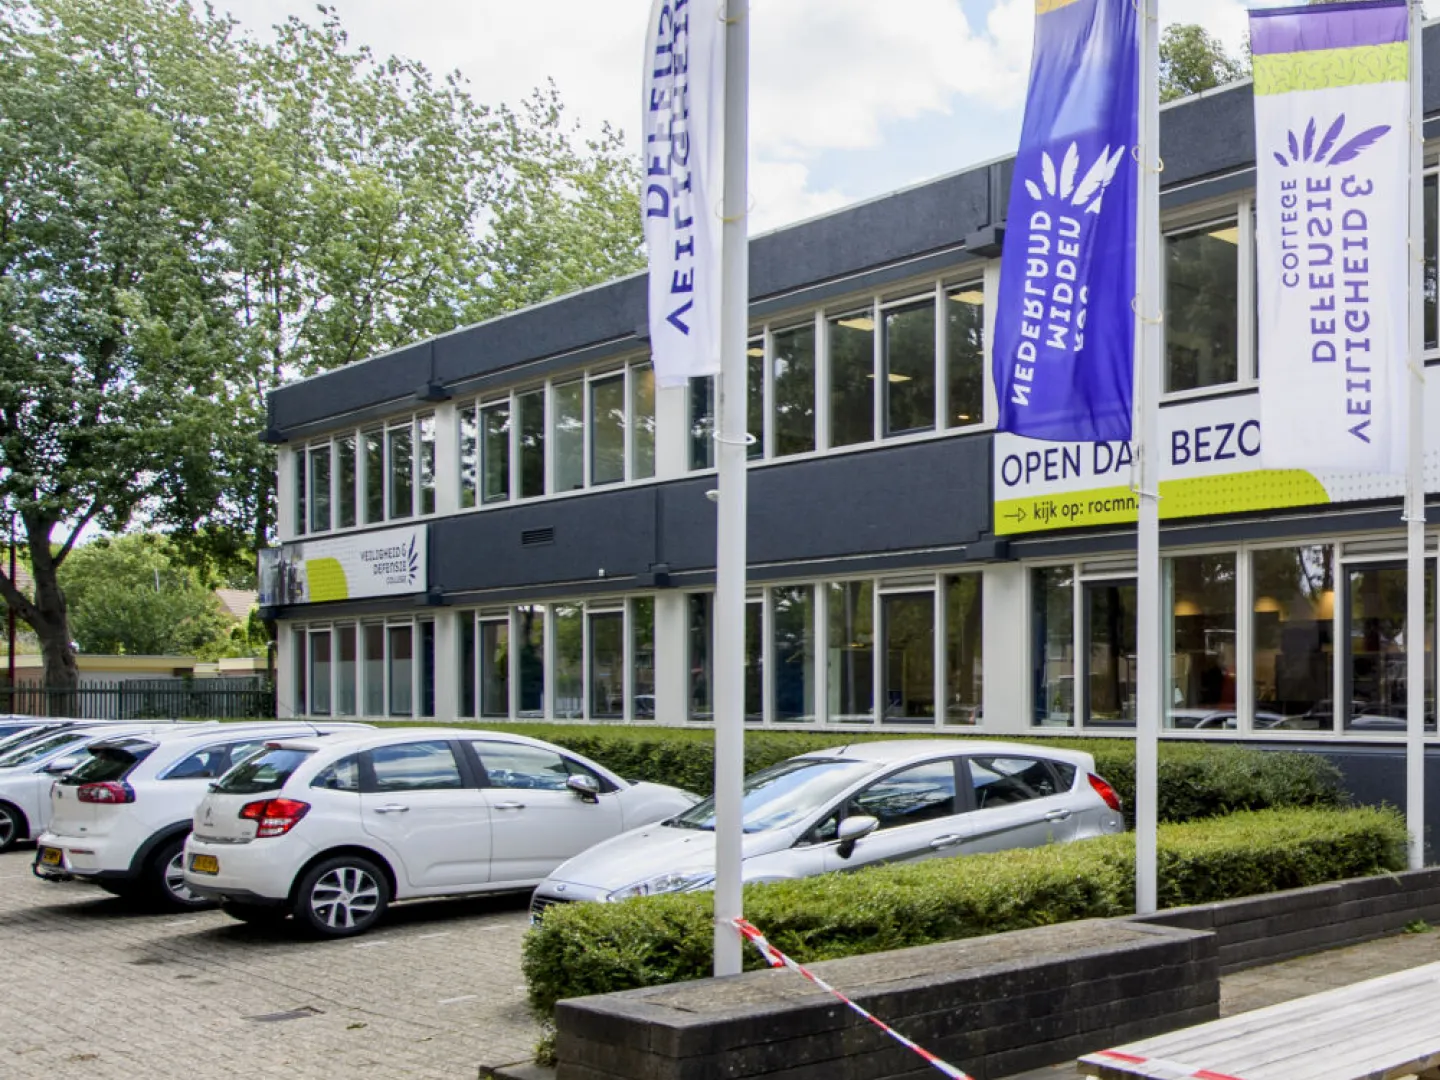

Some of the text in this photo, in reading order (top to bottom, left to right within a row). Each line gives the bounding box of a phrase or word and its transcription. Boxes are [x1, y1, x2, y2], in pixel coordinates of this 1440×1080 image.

[1001, 444, 1081, 487] OPEN
[1093, 441, 1139, 475] DA
[1033, 502, 1057, 524] kijk
[1063, 504, 1084, 521] op:
[360, 546, 400, 562] VEILIGHEID
[373, 561, 407, 575] DEFENSIE
